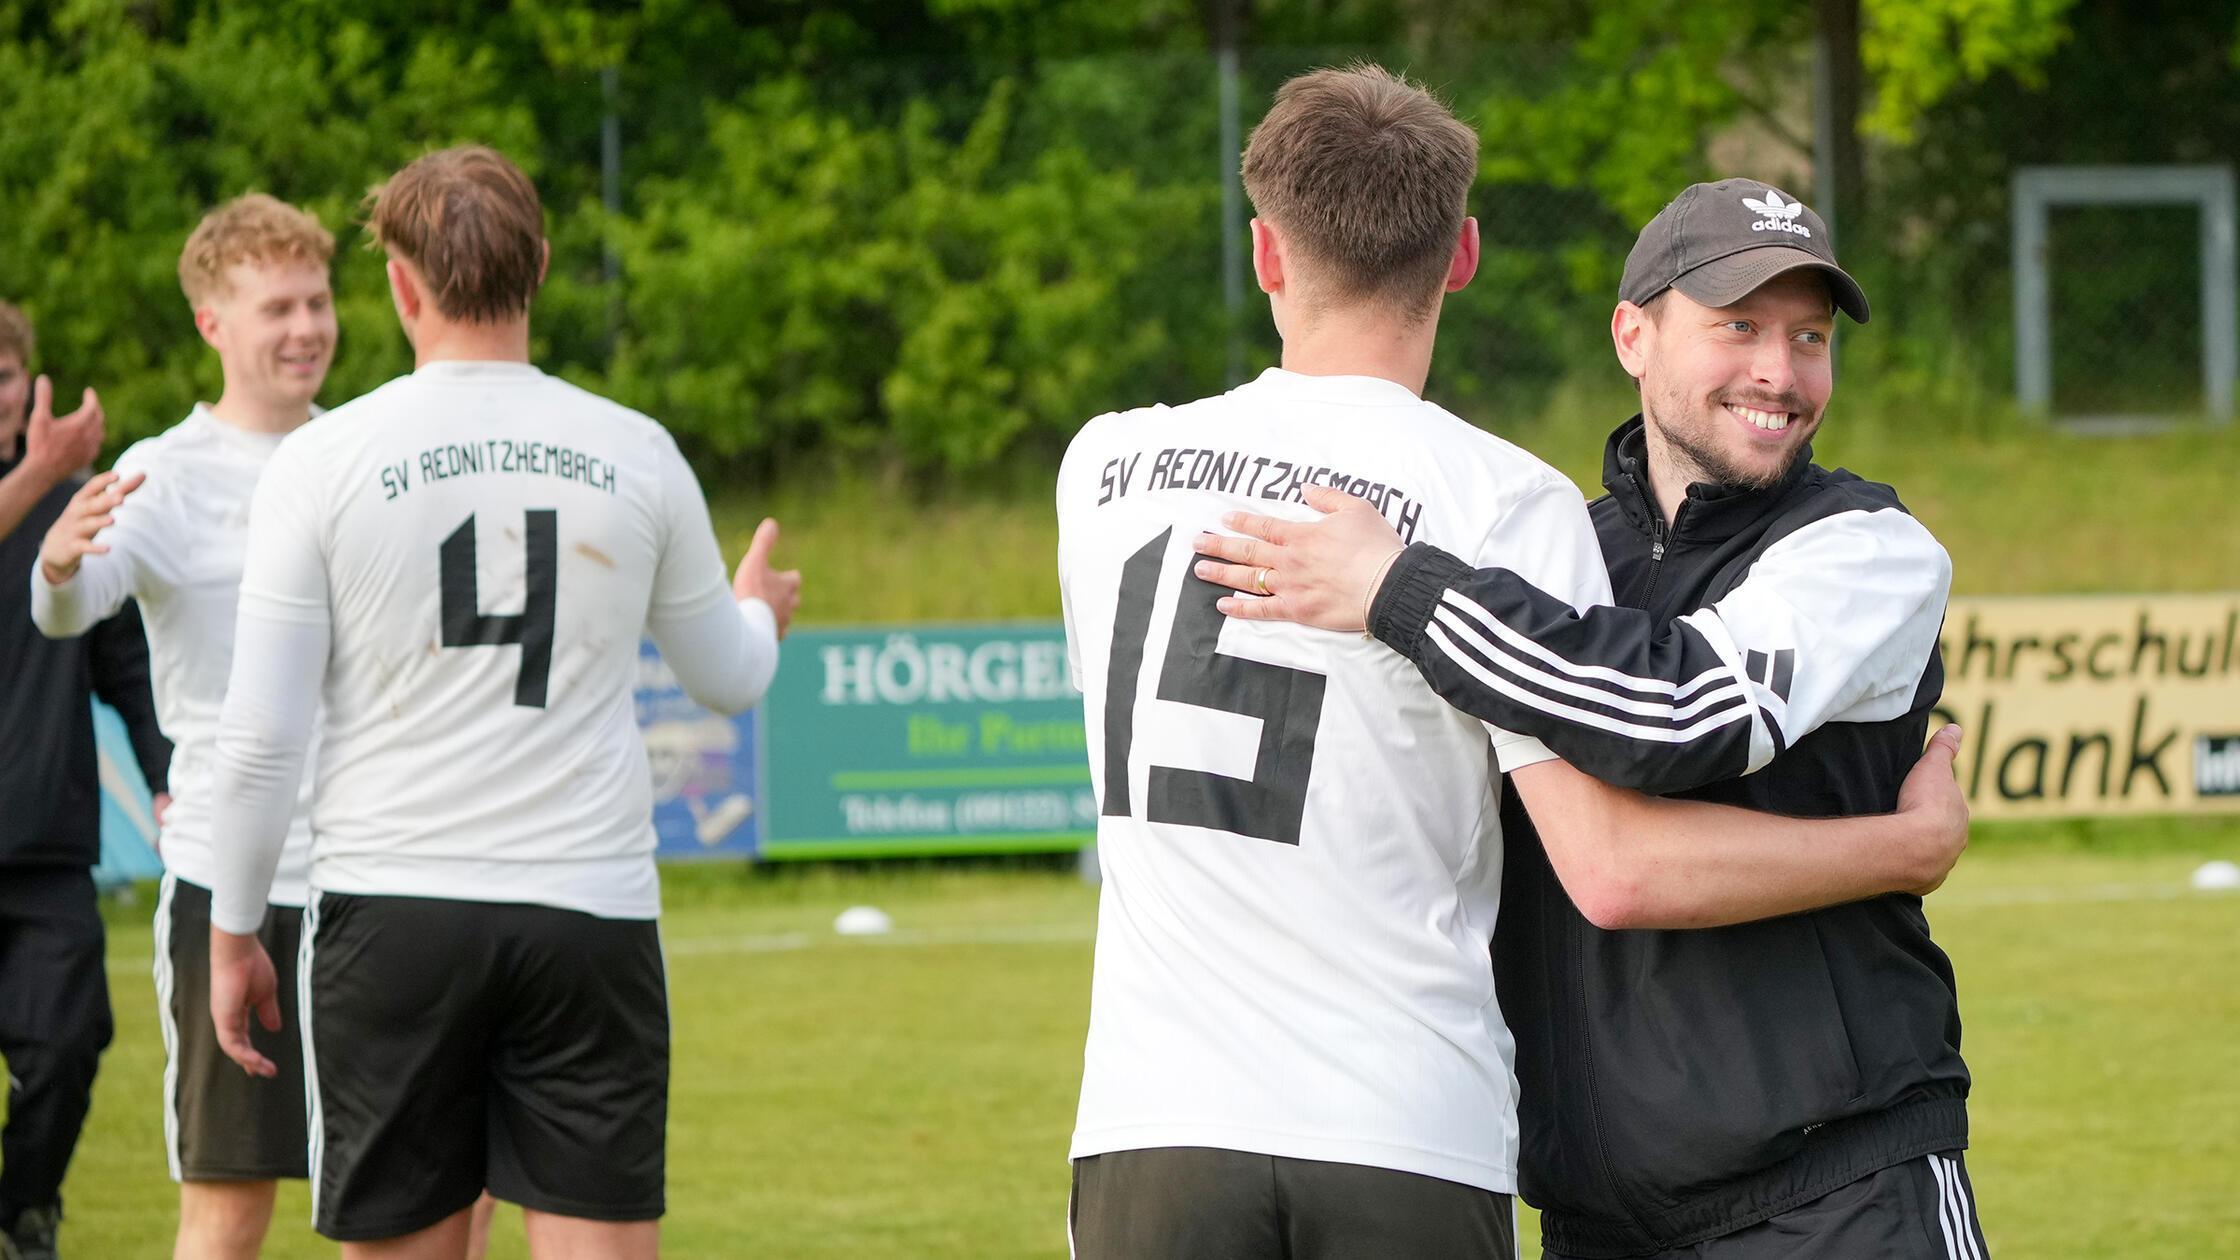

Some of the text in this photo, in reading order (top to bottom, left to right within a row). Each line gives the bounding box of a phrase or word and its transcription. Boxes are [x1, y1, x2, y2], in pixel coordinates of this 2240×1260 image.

[1751, 217, 1811, 238] adidas
[381, 439, 616, 501] SV REDNITZHEMBACH
[1097, 451, 1142, 507] SV
[439, 508, 558, 709] 4
[821, 633, 1082, 703] HÖRGE
[1941, 613, 2238, 682] hrschul
[1101, 524, 1328, 847] 15
[1930, 694, 2177, 801] lank
